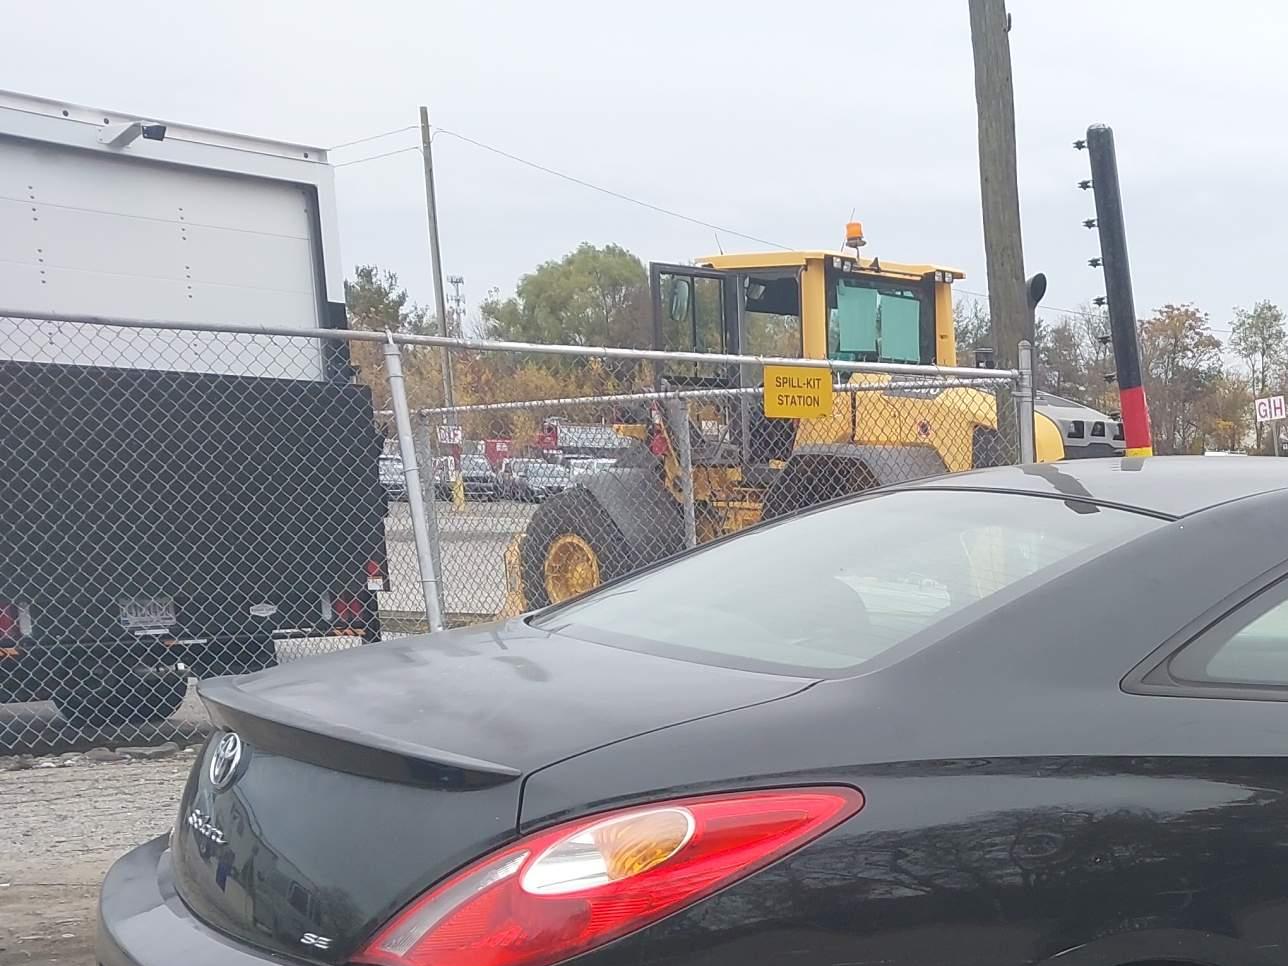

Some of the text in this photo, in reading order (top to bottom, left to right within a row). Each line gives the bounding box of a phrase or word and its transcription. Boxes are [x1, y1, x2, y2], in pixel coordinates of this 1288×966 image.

[775, 376, 821, 389] SPILL-KIT
[777, 394, 820, 407] STATION
[300, 932, 333, 949] SE
